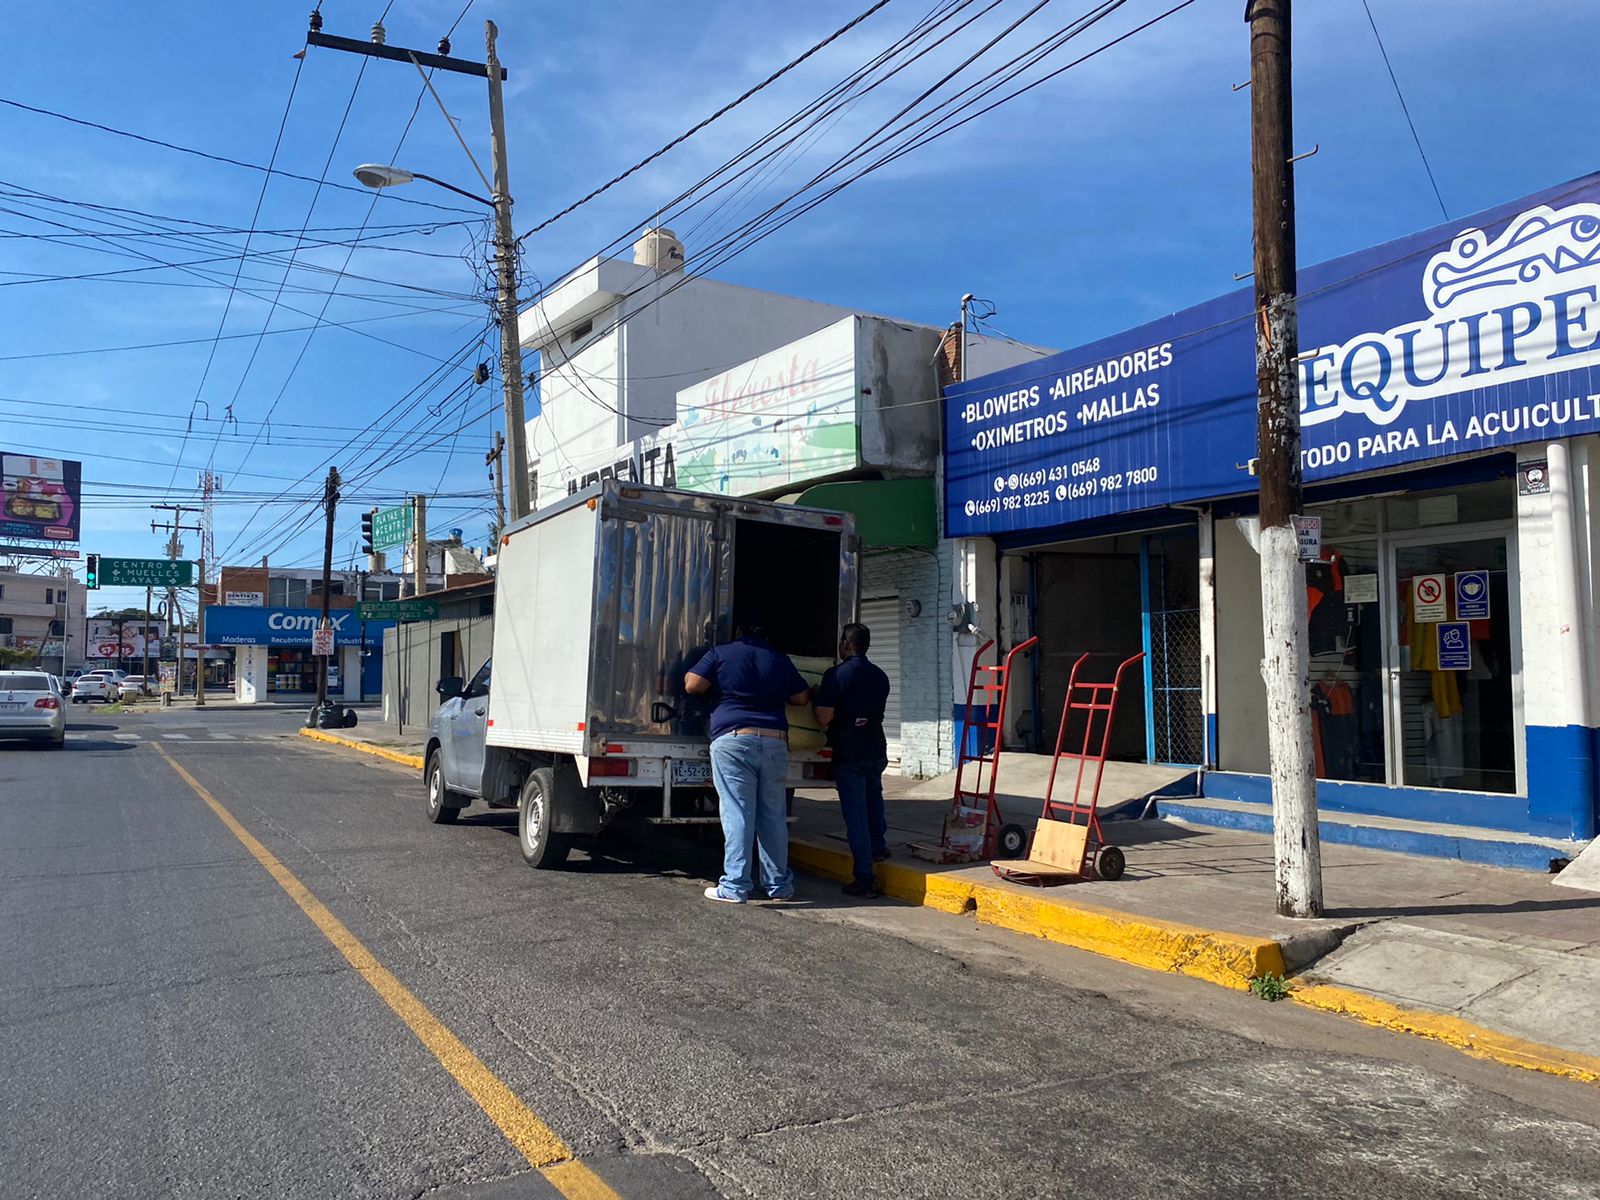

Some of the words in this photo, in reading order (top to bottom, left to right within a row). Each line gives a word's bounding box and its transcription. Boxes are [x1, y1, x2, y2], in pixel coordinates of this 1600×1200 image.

[966, 385, 1040, 424] BLOWERS
[1053, 342, 1173, 401] AIREADORES
[975, 410, 1068, 451] OXIMETROS
[1082, 383, 1161, 426] MALLAS
[1300, 442, 1351, 471] TODO
[1357, 431, 1420, 459] PARA
[1426, 424, 1459, 446] LA
[1465, 394, 1600, 440] ACUICULT
[1019, 468, 1046, 490] (669)
[1048, 464, 1068, 483] 431
[1071, 456, 1101, 477] 0548
[975, 500, 1001, 516] (669)
[1002, 494, 1022, 512] 982
[1023, 490, 1050, 508] 8225
[1067, 478, 1099, 500] (669)
[1100, 473, 1123, 492] 982
[1126, 465, 1158, 486] 7800
[376, 510, 398, 525] PLAYAS
[113, 561, 163, 569] CENTRO
[127, 569, 180, 577] MUELLES
[222, 636, 256, 644] Maderas
[271, 636, 313, 644] Recubrimien
[337, 637, 375, 645] Industriles
